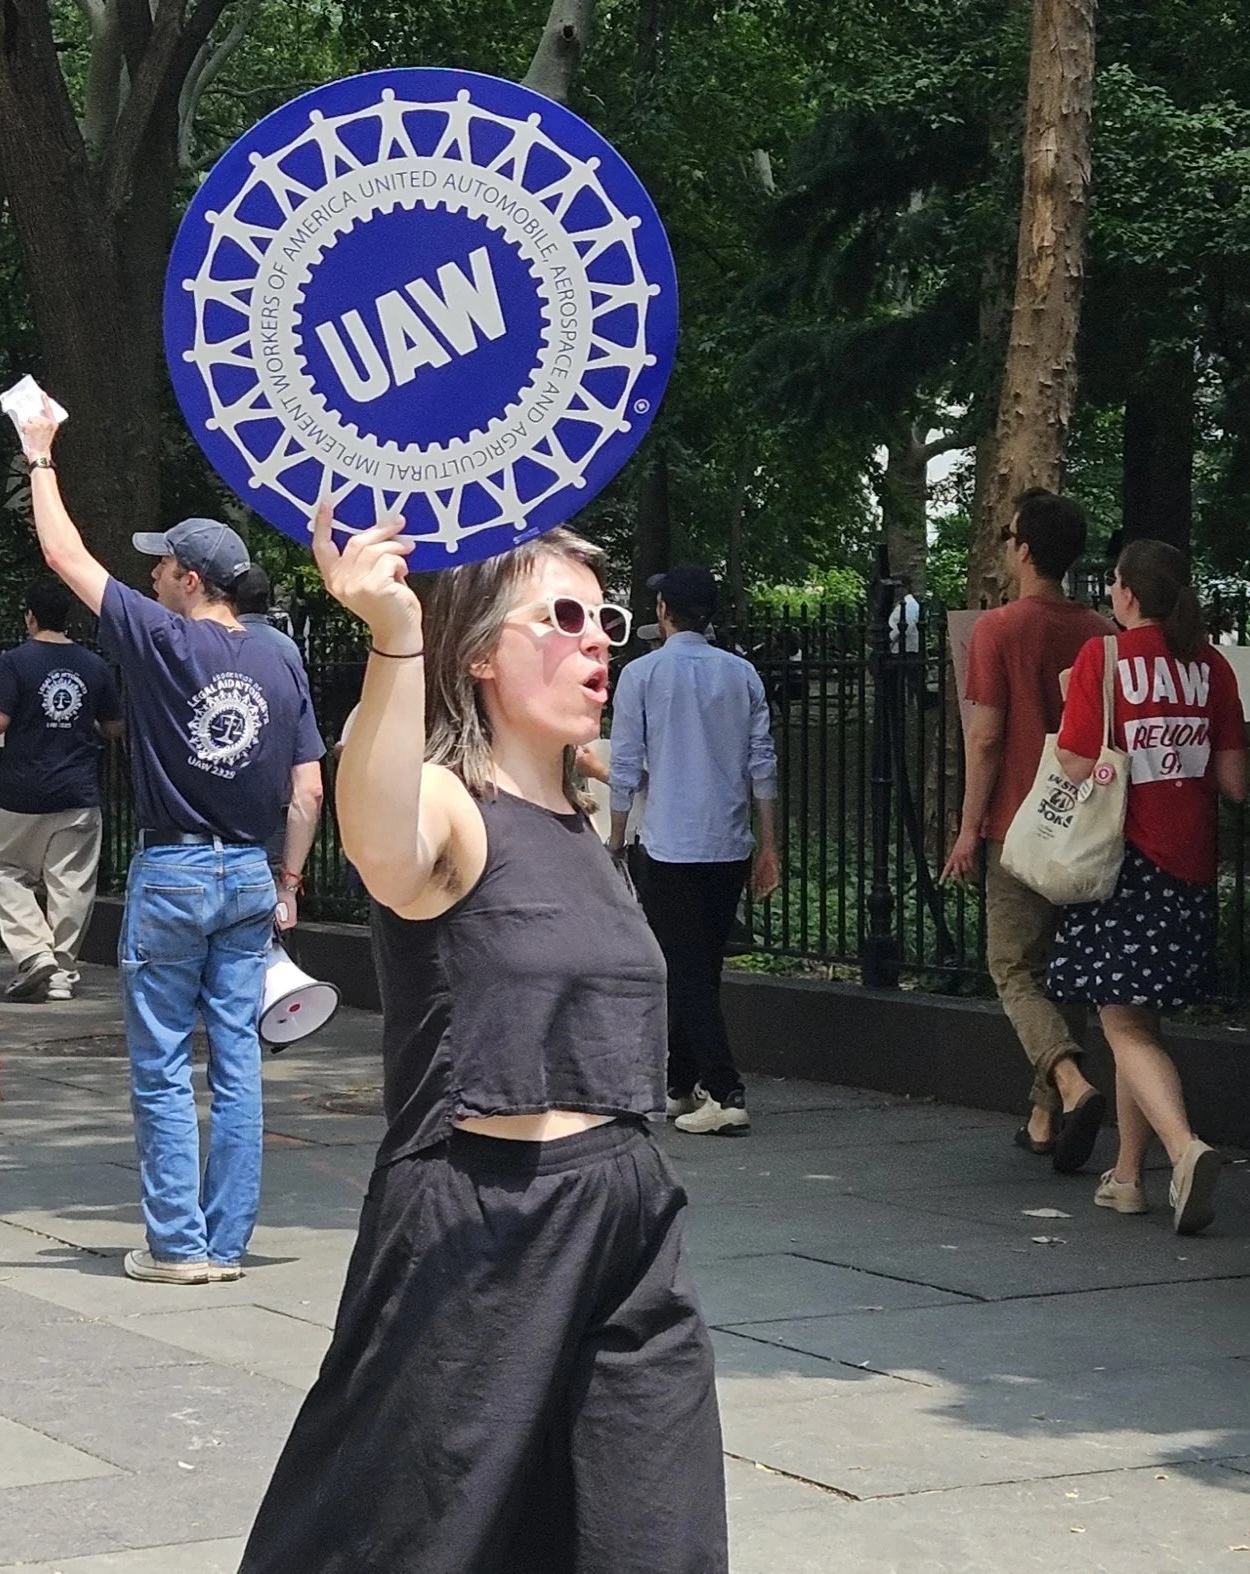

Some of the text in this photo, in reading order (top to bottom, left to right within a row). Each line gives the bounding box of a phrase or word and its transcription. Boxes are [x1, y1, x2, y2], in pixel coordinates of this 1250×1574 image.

[261, 170, 578, 481] UNITED AUTOMOBILE, AEROSPACE AND AGRICULTURAL IMPLEMENT WORKERS OF AMERICA
[314, 245, 508, 403] UAW
[186, 683, 218, 708] LEGAL
[217, 679, 235, 690] AID
[1117, 656, 1211, 707] UAW
[187, 755, 213, 772] UAW
